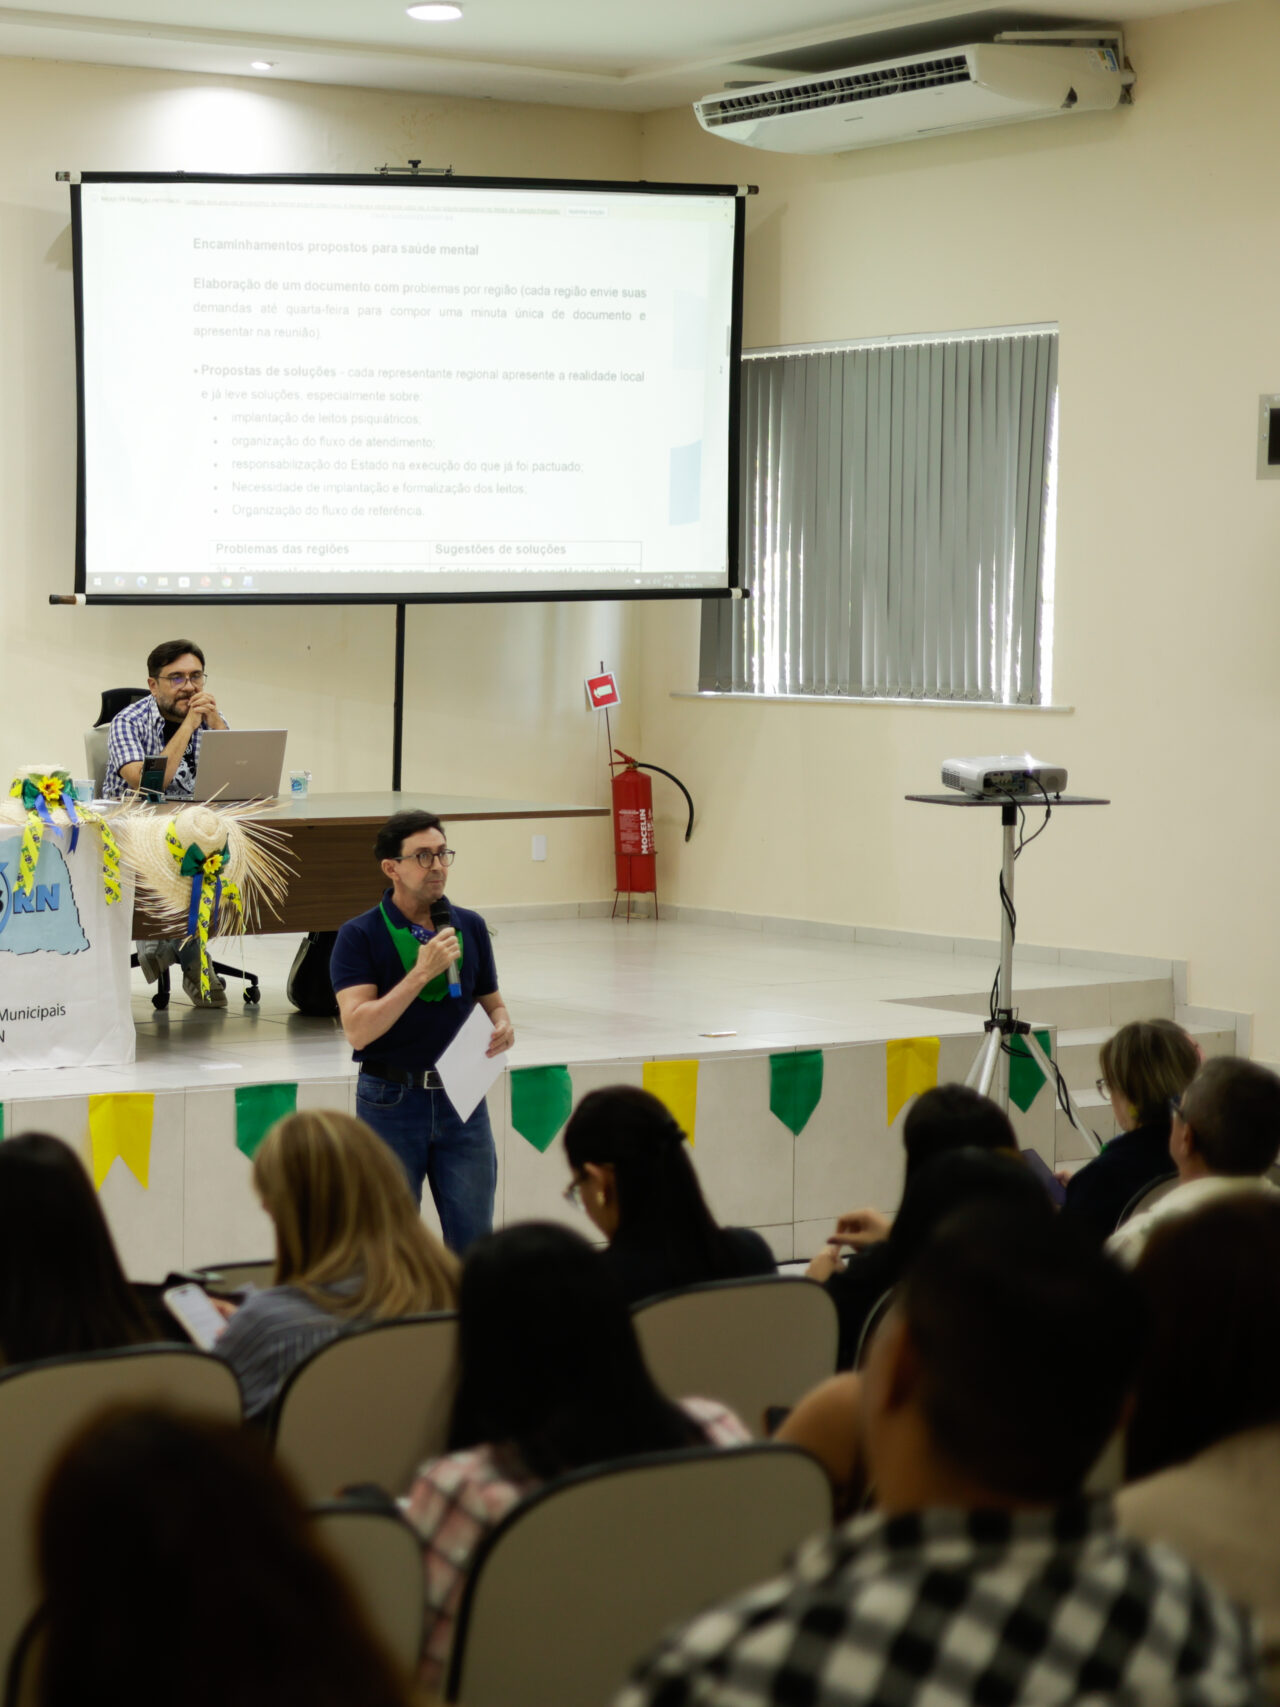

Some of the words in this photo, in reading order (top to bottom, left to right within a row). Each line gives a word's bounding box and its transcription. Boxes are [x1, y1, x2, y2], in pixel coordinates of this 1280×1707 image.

[192, 237, 304, 252] Encaminhamentos
[306, 241, 368, 256] propostos
[370, 243, 398, 257] para
[400, 243, 438, 254] saúde
[438, 244, 480, 256] mental
[192, 276, 262, 293] Elaboração
[264, 280, 280, 291] de
[282, 281, 302, 291] um
[304, 280, 372, 292] documento
[374, 283, 400, 293] com
[402, 282, 460, 297] problemas
[462, 285, 482, 297] por
[484, 283, 518, 299] região
[520, 285, 552, 297] (cada
[552, 285, 588, 300] região
[588, 288, 620, 298] envie
[620, 288, 648, 298] suas
[194, 302, 252, 313] demandas
[260, 303, 278, 314] até
[286, 303, 350, 318] quarta-feira
[358, 306, 382, 318] para
[390, 306, 432, 321] compor
[440, 308, 462, 318] uma
[470, 307, 508, 319] minuta
[514, 307, 544, 319] única
[552, 309, 566, 320] de
[572, 308, 632, 321] documento
[640, 311, 646, 320] e
[194, 325, 252, 340] apresentar
[256, 328, 270, 337] na
[200, 364, 262, 380] Propostas
[266, 364, 280, 376] de
[282, 364, 336, 380] soluções
[348, 368, 374, 378] cada
[378, 368, 452, 381] representante
[456, 368, 498, 383] regional
[502, 370, 556, 382] apresente
[558, 372, 566, 382] a
[568, 370, 618, 382] realidade
[620, 371, 644, 383] local
[200, 390, 208, 399] e
[210, 388, 222, 402] já
[224, 389, 248, 399] leve
[306, 391, 386, 403] especialmente
[232, 410, 300, 426] implantação
[300, 413, 316, 423] de
[318, 412, 348, 424] leitos
[232, 434, 298, 450] organização
[302, 434, 316, 447] do
[318, 434, 346, 447] fluxo
[348, 436, 364, 447] de
[232, 458, 330, 473] responsabilização
[334, 459, 348, 470] do
[350, 458, 388, 470] Estado
[392, 462, 406, 470] na
[408, 460, 460, 474] execução
[464, 460, 478, 471] do
[480, 461, 500, 473] que
[504, 461, 514, 474] já
[516, 460, 528, 471] foi
[232, 481, 304, 493] Necessidade
[306, 483, 320, 493] de
[322, 481, 390, 496] implantação
[392, 484, 400, 493] e
[402, 481, 472, 496] formalização
[474, 484, 494, 494] dos
[232, 504, 302, 518] Organização
[304, 506, 320, 515] do
[322, 505, 348, 516] fluxo
[350, 506, 364, 517] de
[216, 543, 278, 554] Problemas
[282, 544, 302, 554] das
[306, 543, 350, 557] regiões
[436, 543, 494, 558] Sugestões
[498, 544, 512, 555] de
[516, 544, 566, 558] soluções
[640, 809, 649, 854] MOCELIN
[13, 884, 60, 914] RN
